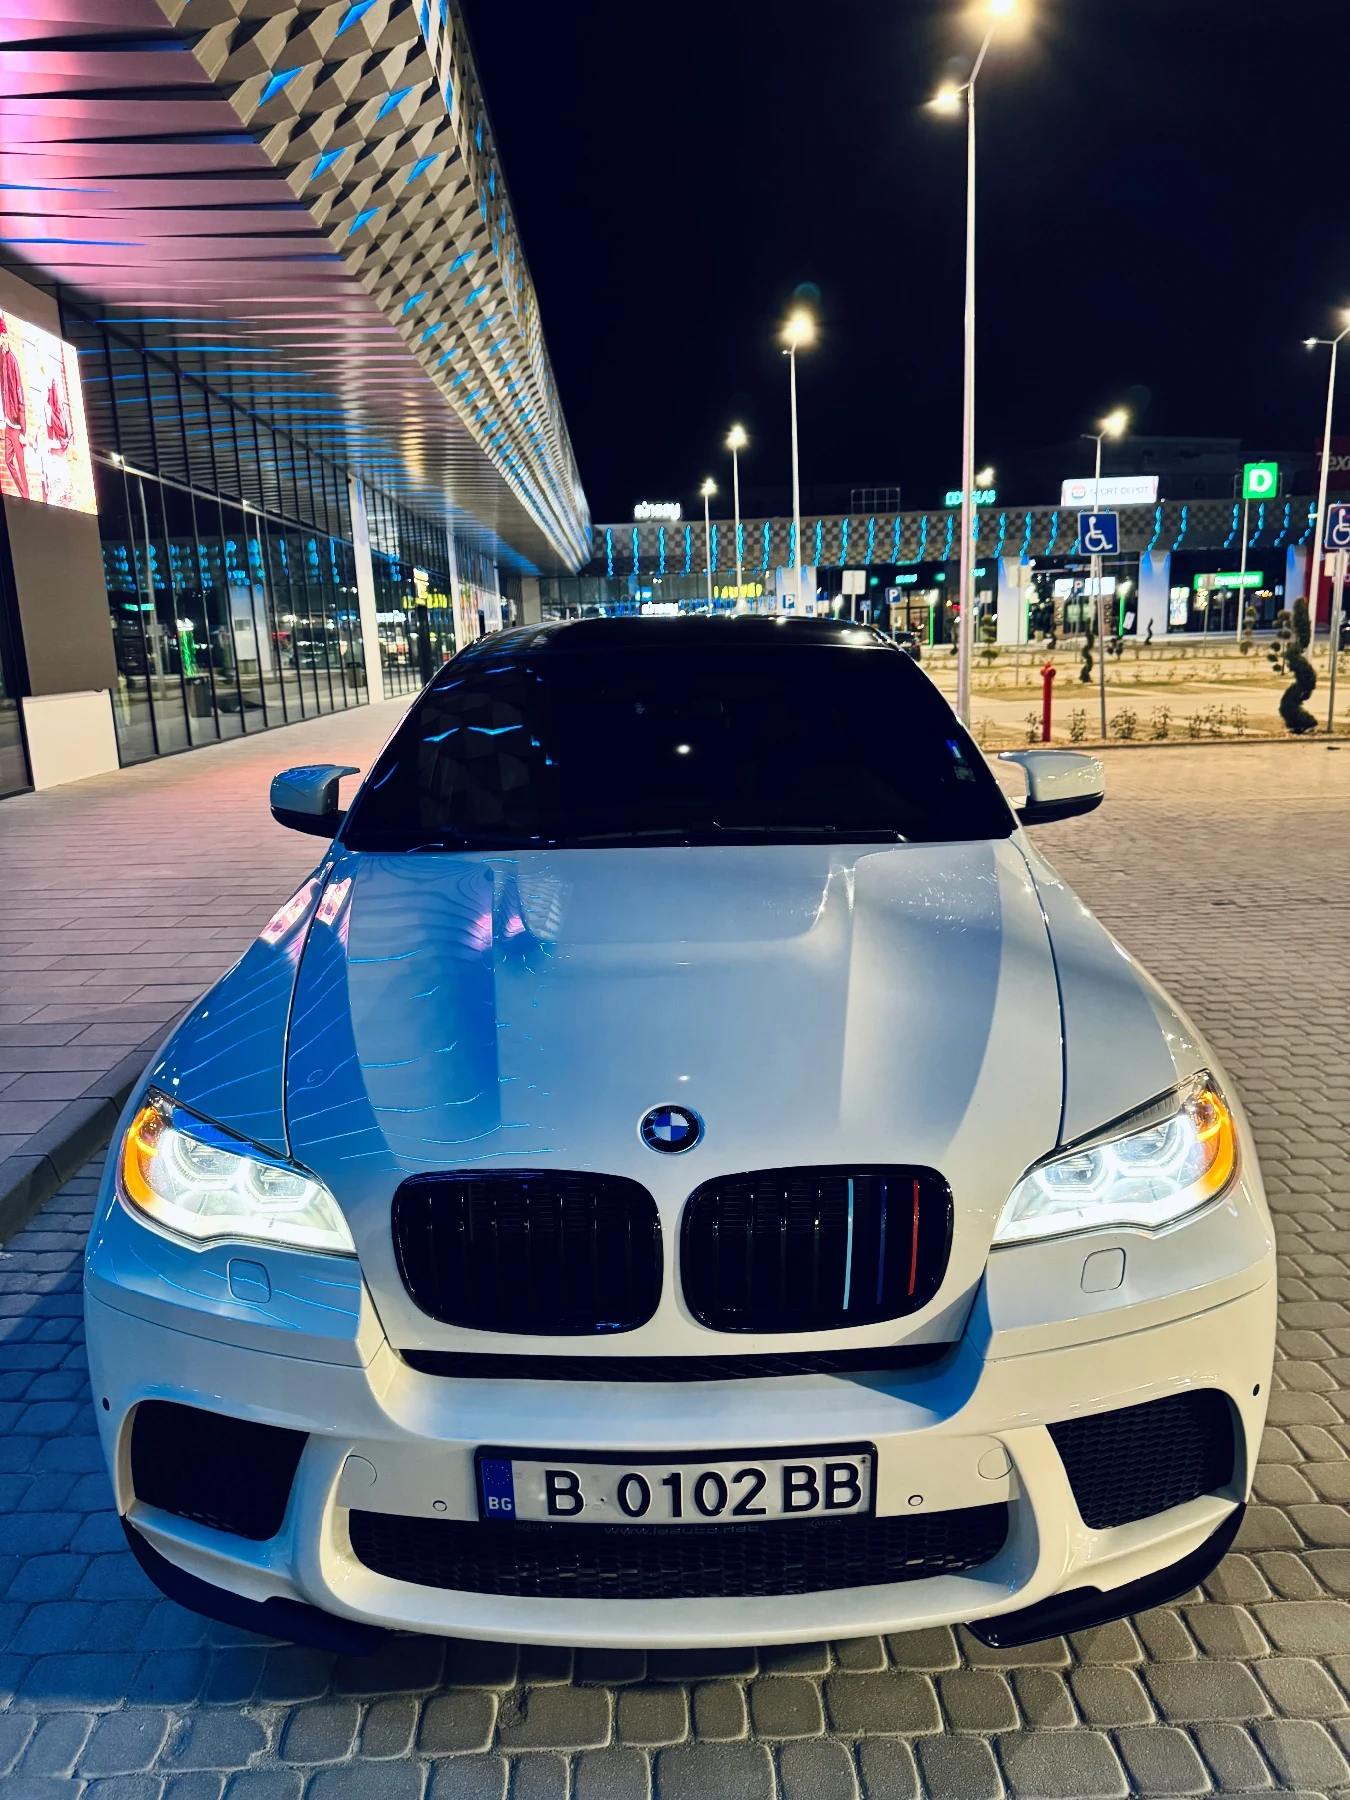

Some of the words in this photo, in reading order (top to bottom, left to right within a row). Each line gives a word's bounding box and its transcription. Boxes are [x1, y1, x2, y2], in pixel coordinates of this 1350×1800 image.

[1316, 452, 1350, 473] Tex
[1249, 468, 1273, 493] D
[945, 489, 996, 505] DOLAS
[1089, 487, 1117, 496] SORT
[1120, 485, 1149, 495] DEPOT
[889, 589, 898, 602] P
[545, 1469, 586, 1517] B
[616, 1467, 769, 1518] 0102
[783, 1461, 863, 1514] BB
[488, 1495, 513, 1512] BG
